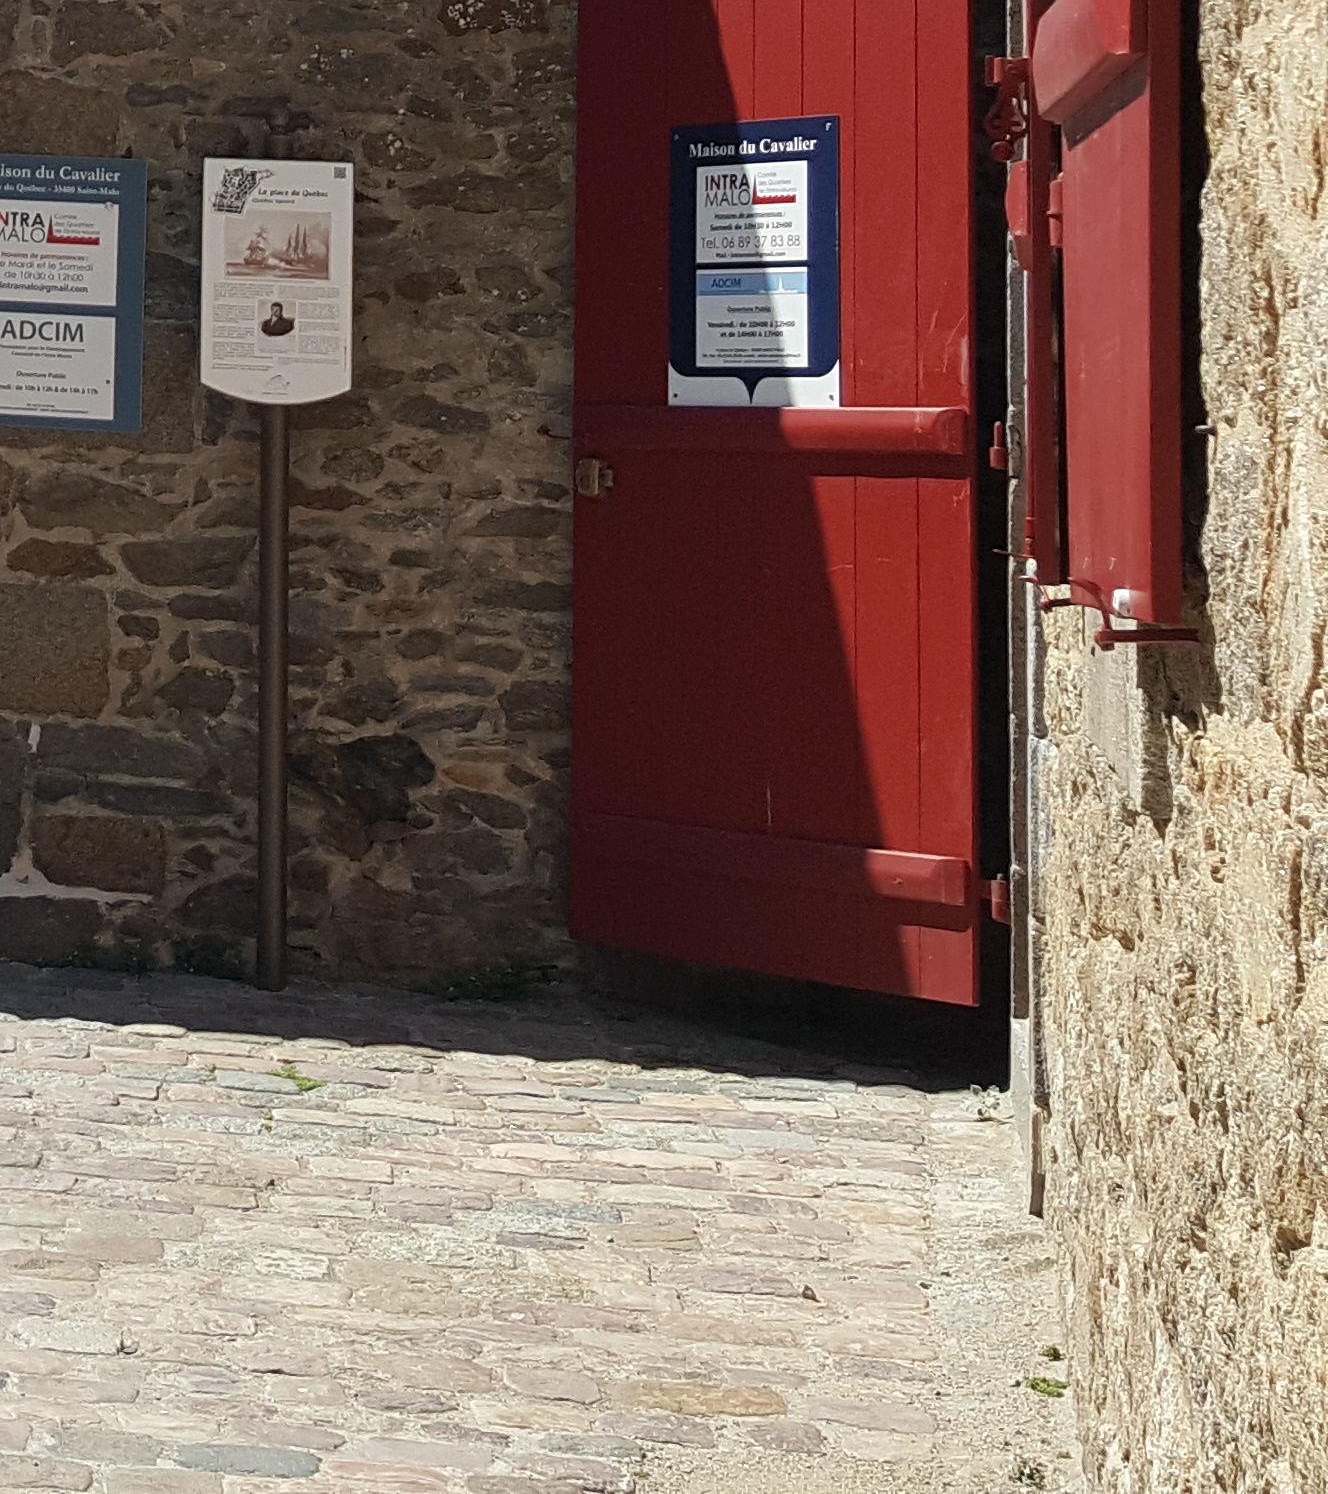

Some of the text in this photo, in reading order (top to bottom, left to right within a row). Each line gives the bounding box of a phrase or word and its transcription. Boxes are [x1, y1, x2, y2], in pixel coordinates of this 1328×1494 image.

[689, 136, 818, 158] Maison du Cavalier
[36, 164, 55, 179] du
[59, 166, 120, 182] Cavalier
[705, 173, 750, 191] INTRA
[705, 188, 751, 207] MALO
[721, 236, 735, 248] 06
[738, 235, 751, 248] 89
[754, 235, 768, 248] 37
[770, 234, 784, 247] 83
[787, 234, 801, 247] 88
[8, 259, 34, 268] Mardi
[36, 261, 46, 269] et
[48, 261, 56, 270] le
[59, 262, 94, 271] Samedi
[4, 271, 17, 279] de
[20, 271, 46, 280] 10h30
[58, 273, 84, 282] 12h00
[711, 278, 741, 288] ADCIM
[0, 319, 84, 342] ADCIM
